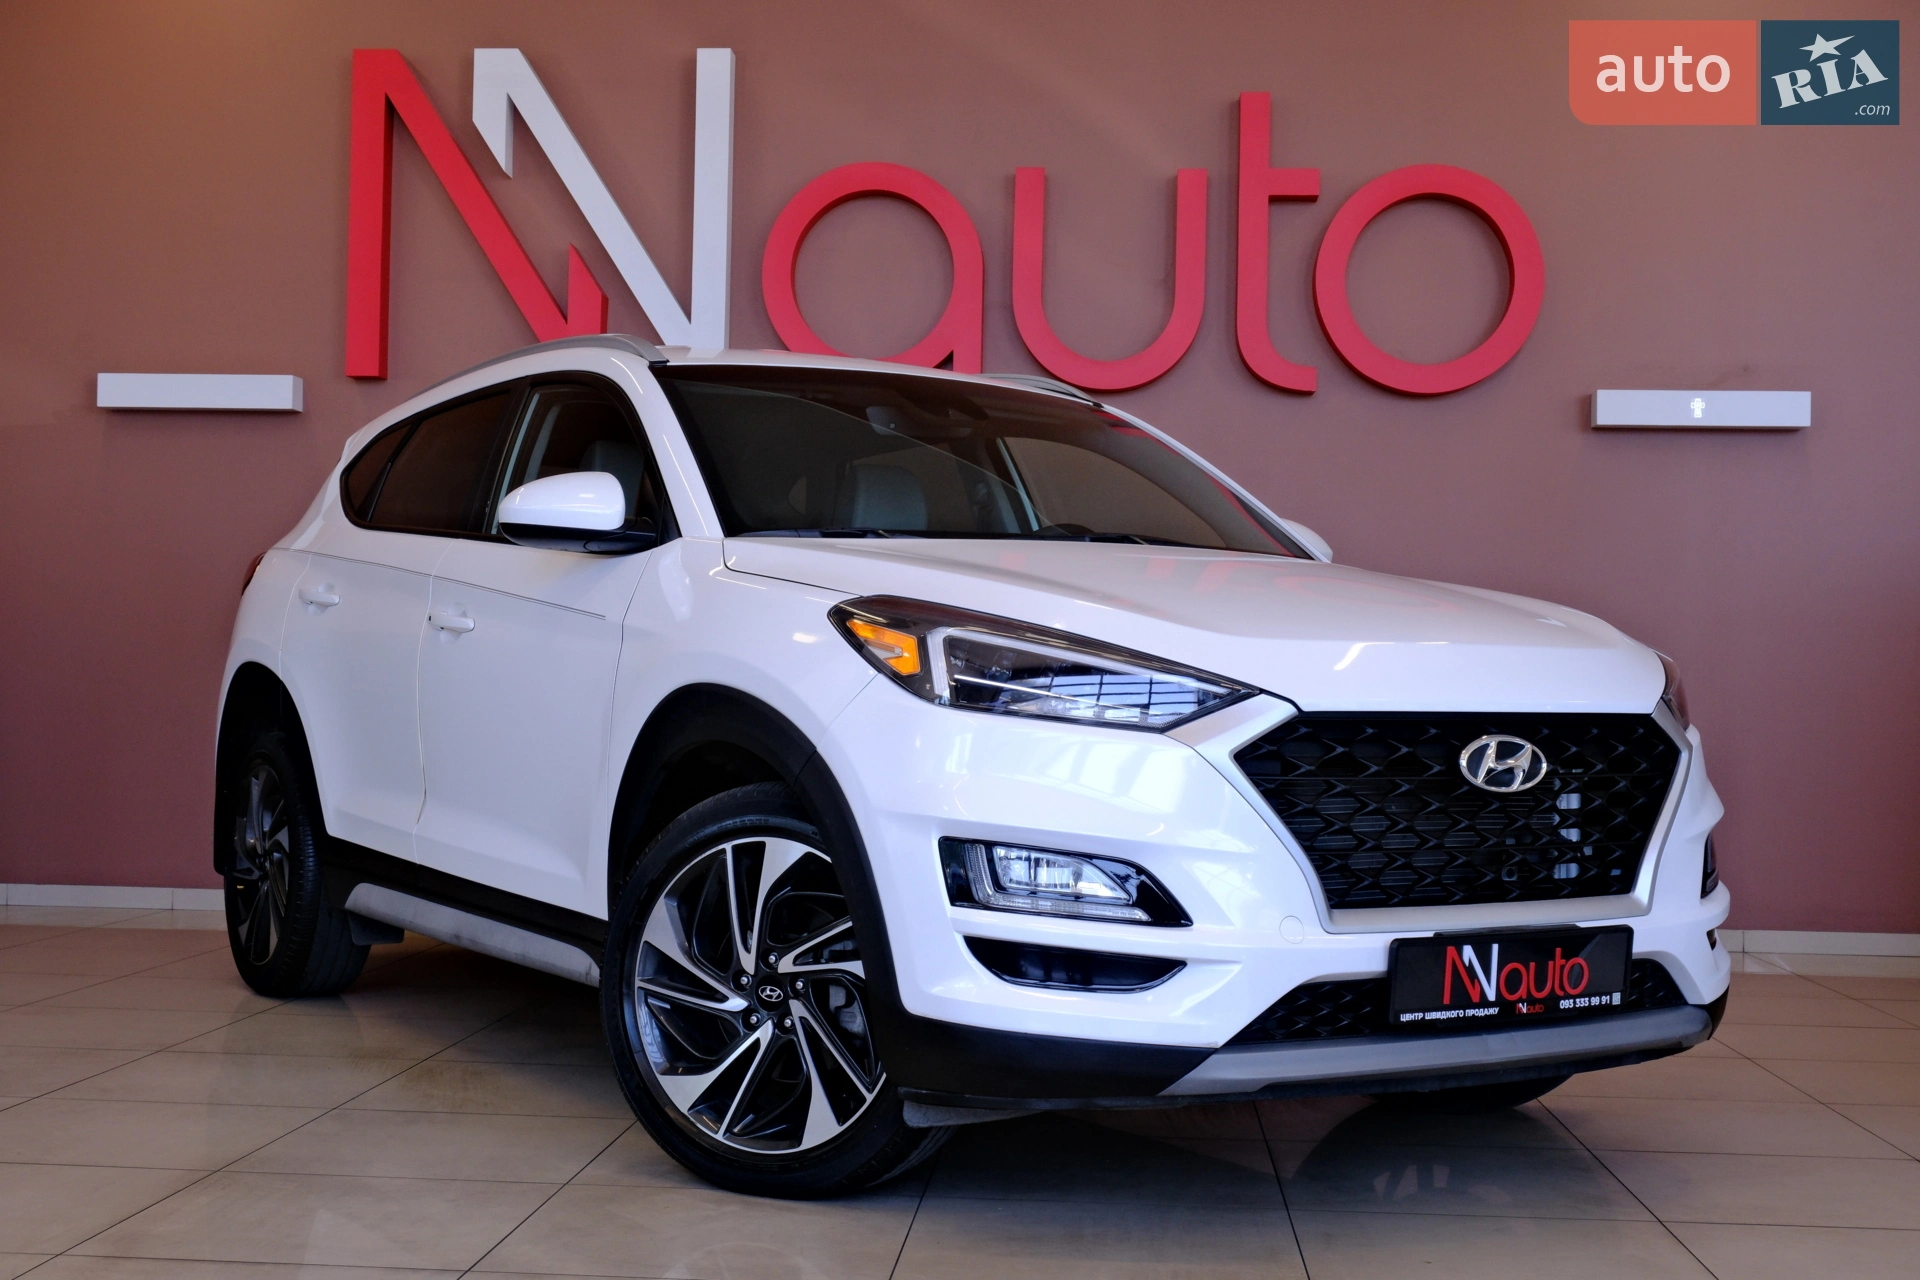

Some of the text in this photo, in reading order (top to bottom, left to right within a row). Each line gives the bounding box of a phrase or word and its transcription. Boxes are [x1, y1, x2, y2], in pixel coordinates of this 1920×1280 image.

[1559, 995, 1610, 1009] 093 333 99 91
[1400, 1007, 1499, 1022] ЦЕНТР ШВИДКОГО ПРОДАЖУ
